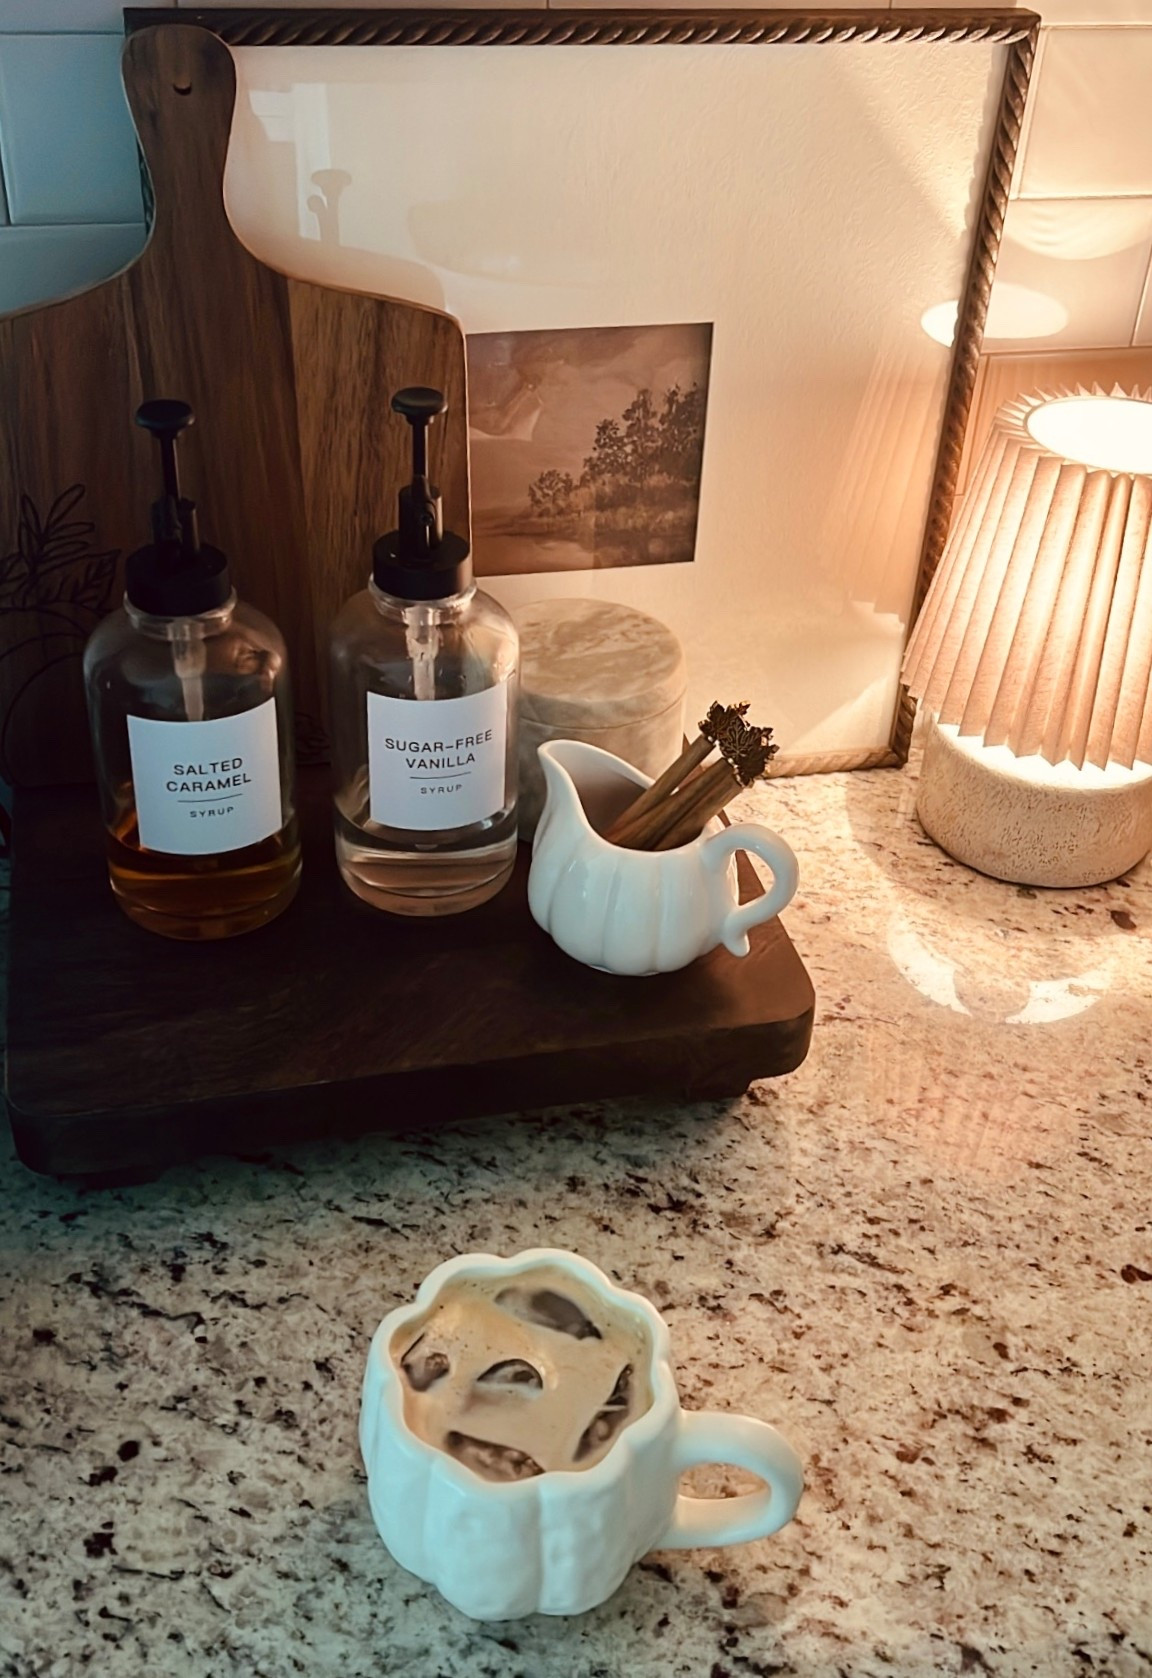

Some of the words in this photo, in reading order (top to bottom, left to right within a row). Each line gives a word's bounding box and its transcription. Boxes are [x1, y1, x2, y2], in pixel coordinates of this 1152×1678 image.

[384, 729, 493, 754] SUGAR-FREE
[173, 757, 244, 777] SALTED
[405, 753, 476, 770] VANILLA
[166, 773, 253, 793] CARAMEL
[420, 784, 464, 795] SYRUP
[189, 806, 235, 818] SYRUP
